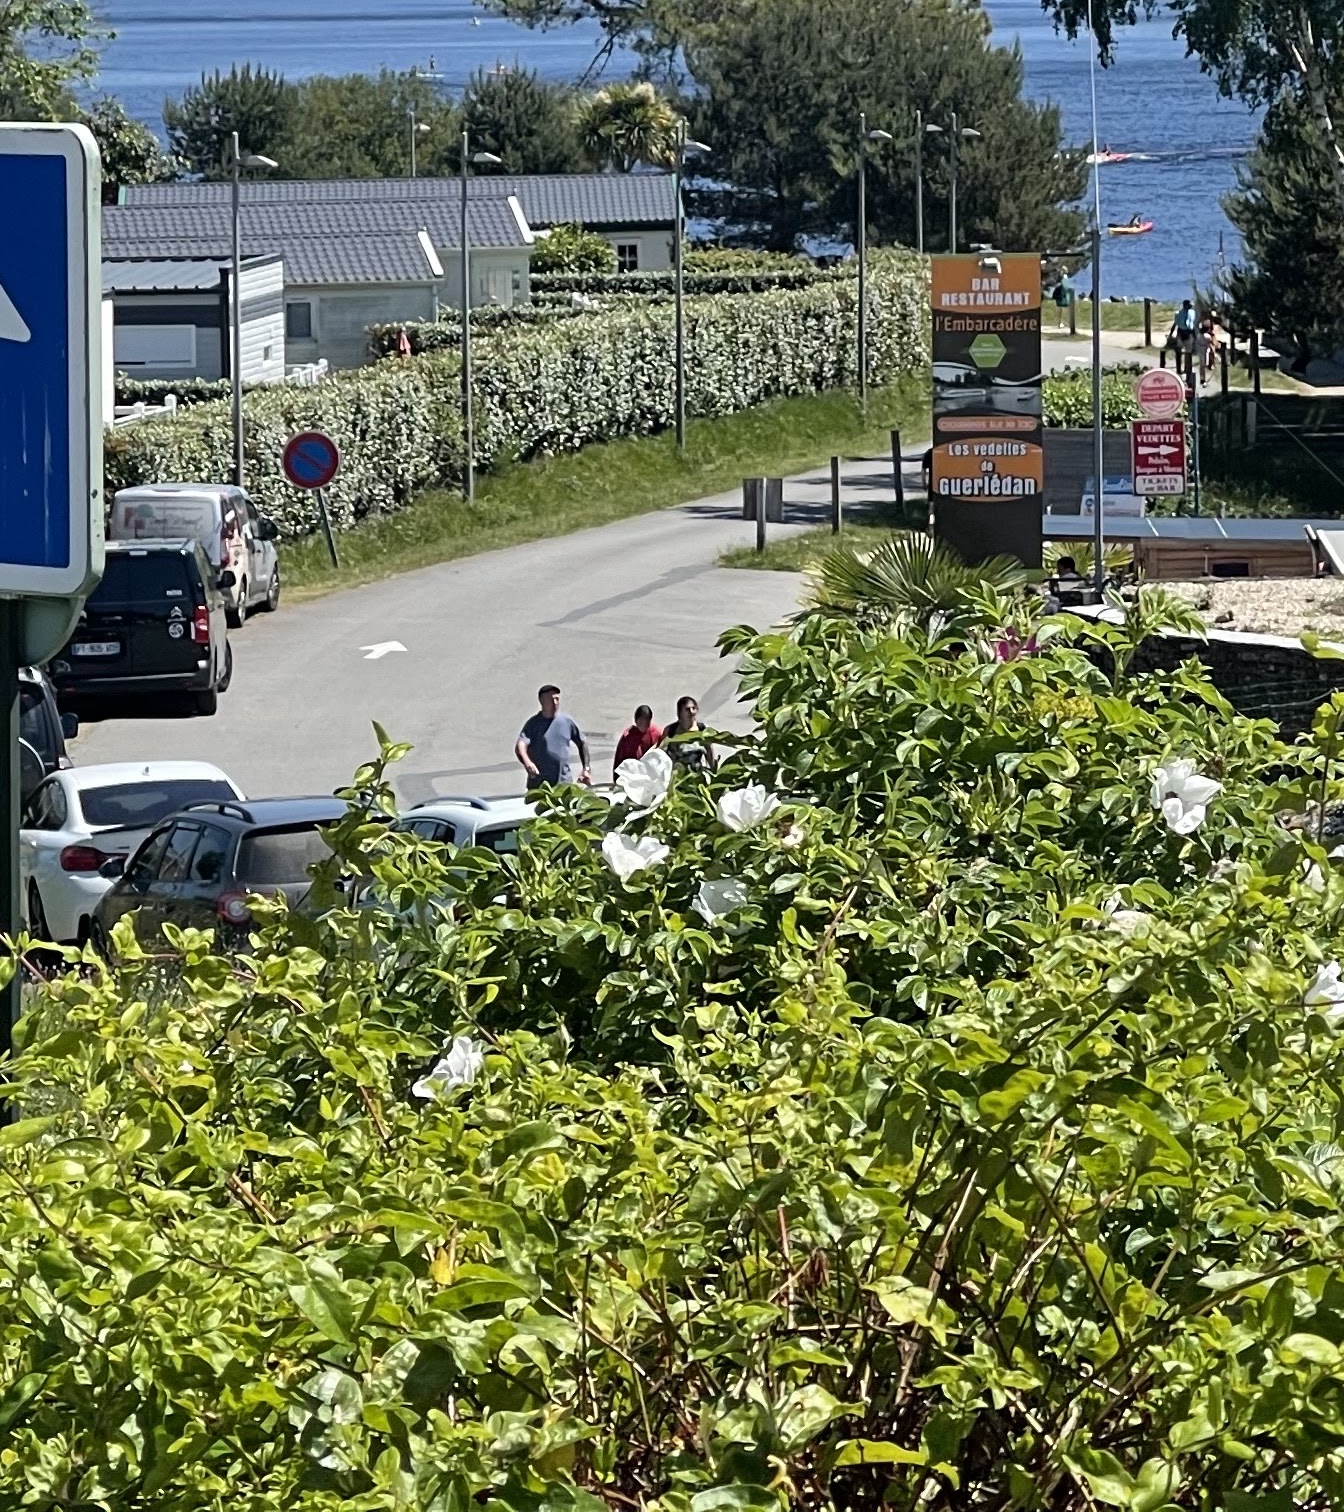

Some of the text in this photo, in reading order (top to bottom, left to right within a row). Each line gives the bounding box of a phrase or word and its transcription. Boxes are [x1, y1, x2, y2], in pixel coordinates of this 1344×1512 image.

[971, 278, 1000, 291] BAR
[941, 292, 1030, 306] RESTAURANT
[948, 443, 969, 456] Les
[980, 460, 994, 472] de
